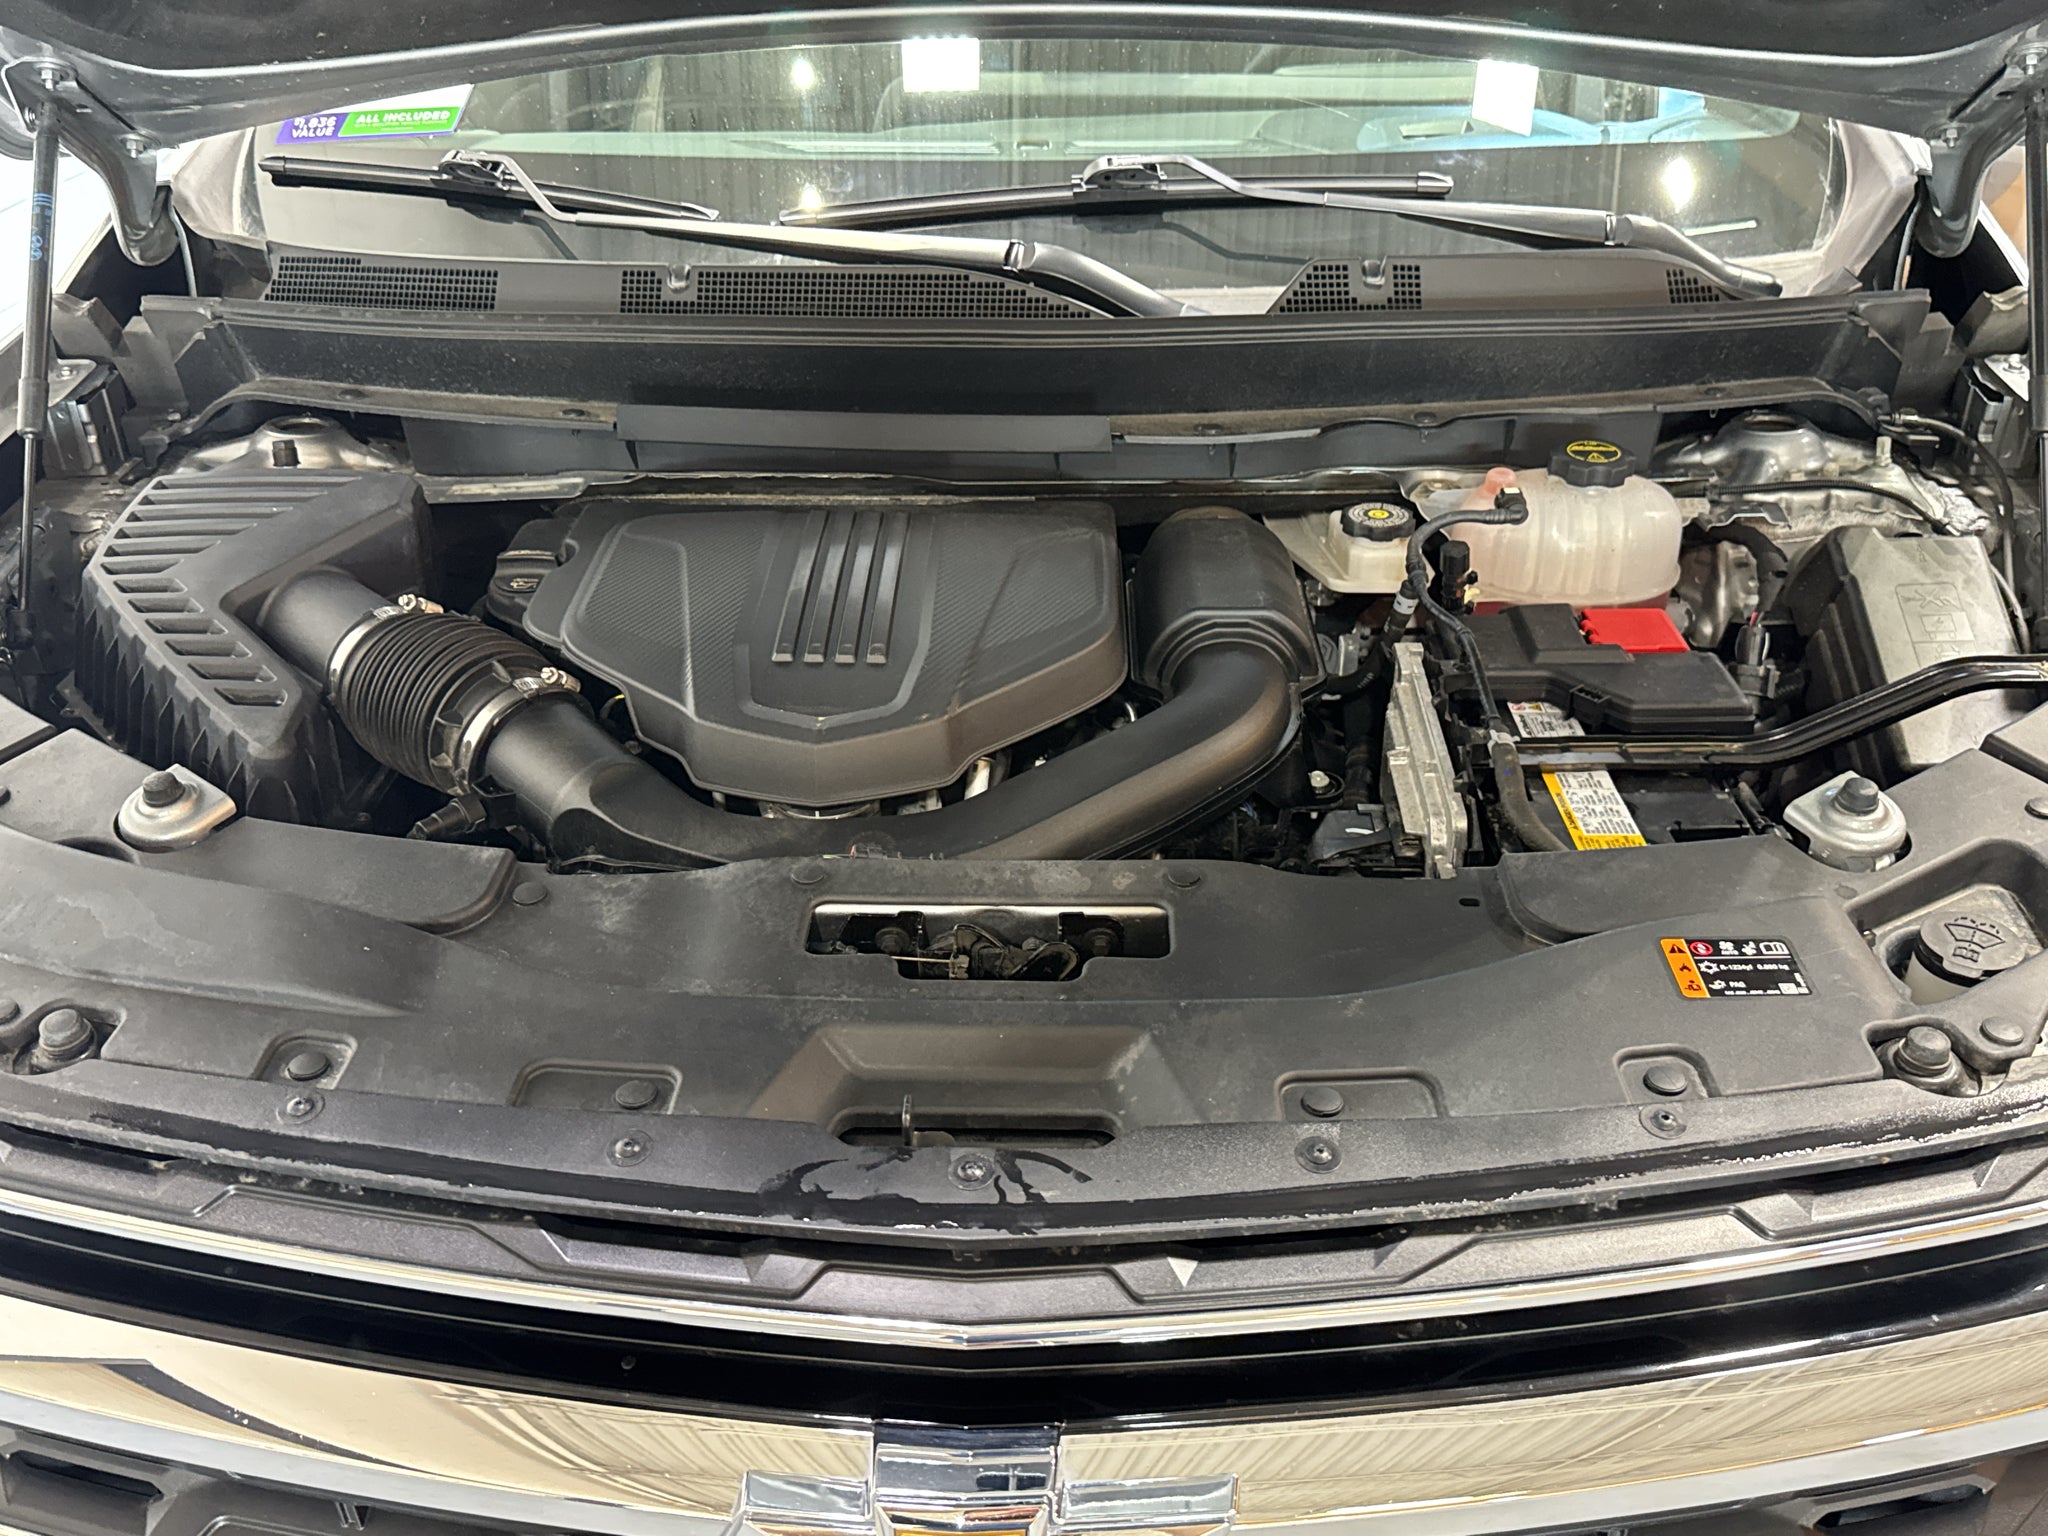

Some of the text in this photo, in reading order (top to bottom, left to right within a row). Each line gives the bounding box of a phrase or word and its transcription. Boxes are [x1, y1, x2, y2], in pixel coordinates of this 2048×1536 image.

[355, 110, 450, 124] ALL INCLUDED
[292, 126, 335, 138] VALUE
